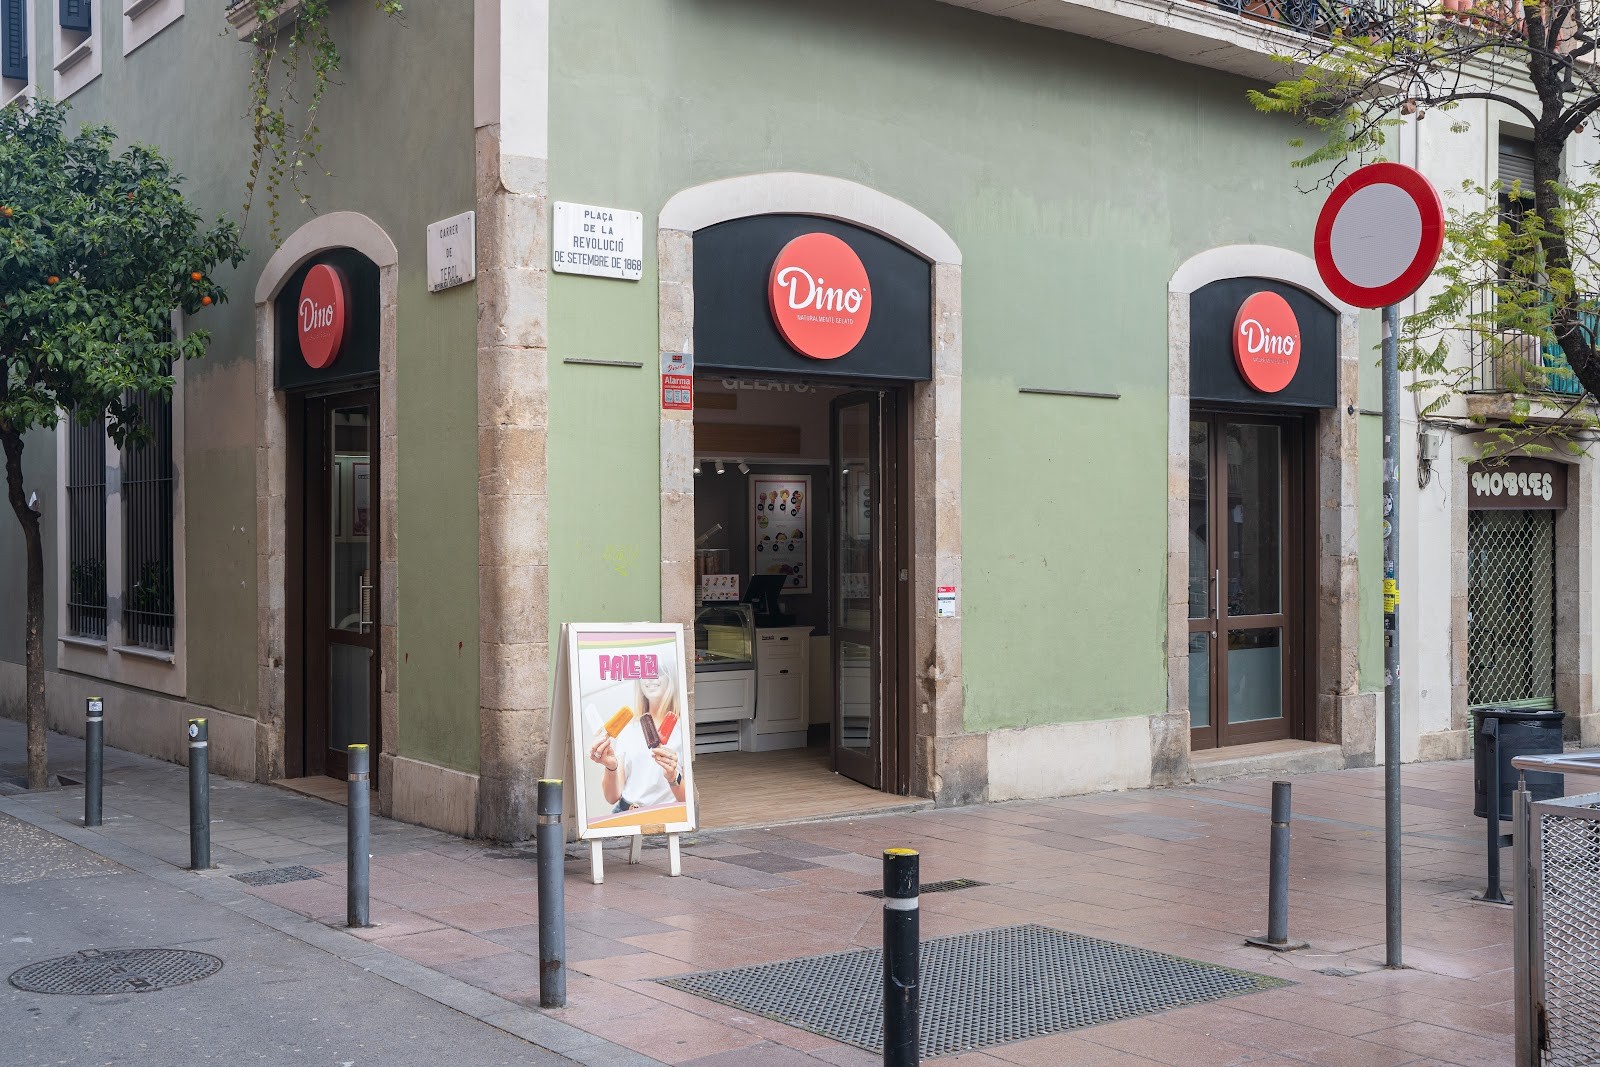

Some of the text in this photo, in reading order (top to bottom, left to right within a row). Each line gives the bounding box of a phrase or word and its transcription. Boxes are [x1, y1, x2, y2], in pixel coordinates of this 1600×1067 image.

[584, 210, 614, 222] PLAÇA
[439, 224, 459, 239] CARRER
[583, 223, 614, 235] DE LA
[573, 235, 624, 253] REVOLUCIÓ
[445, 247, 453, 258] DE
[554, 250, 642, 271] DE SETEMBRE DE 1868
[777, 266, 863, 314] Dino
[299, 297, 334, 333] Dino
[796, 314, 854, 325] NATURALMENTE GELATO
[1240, 318, 1296, 356] Dino
[665, 376, 690, 385] Alarma
[1471, 471, 1553, 501] MOBLES
